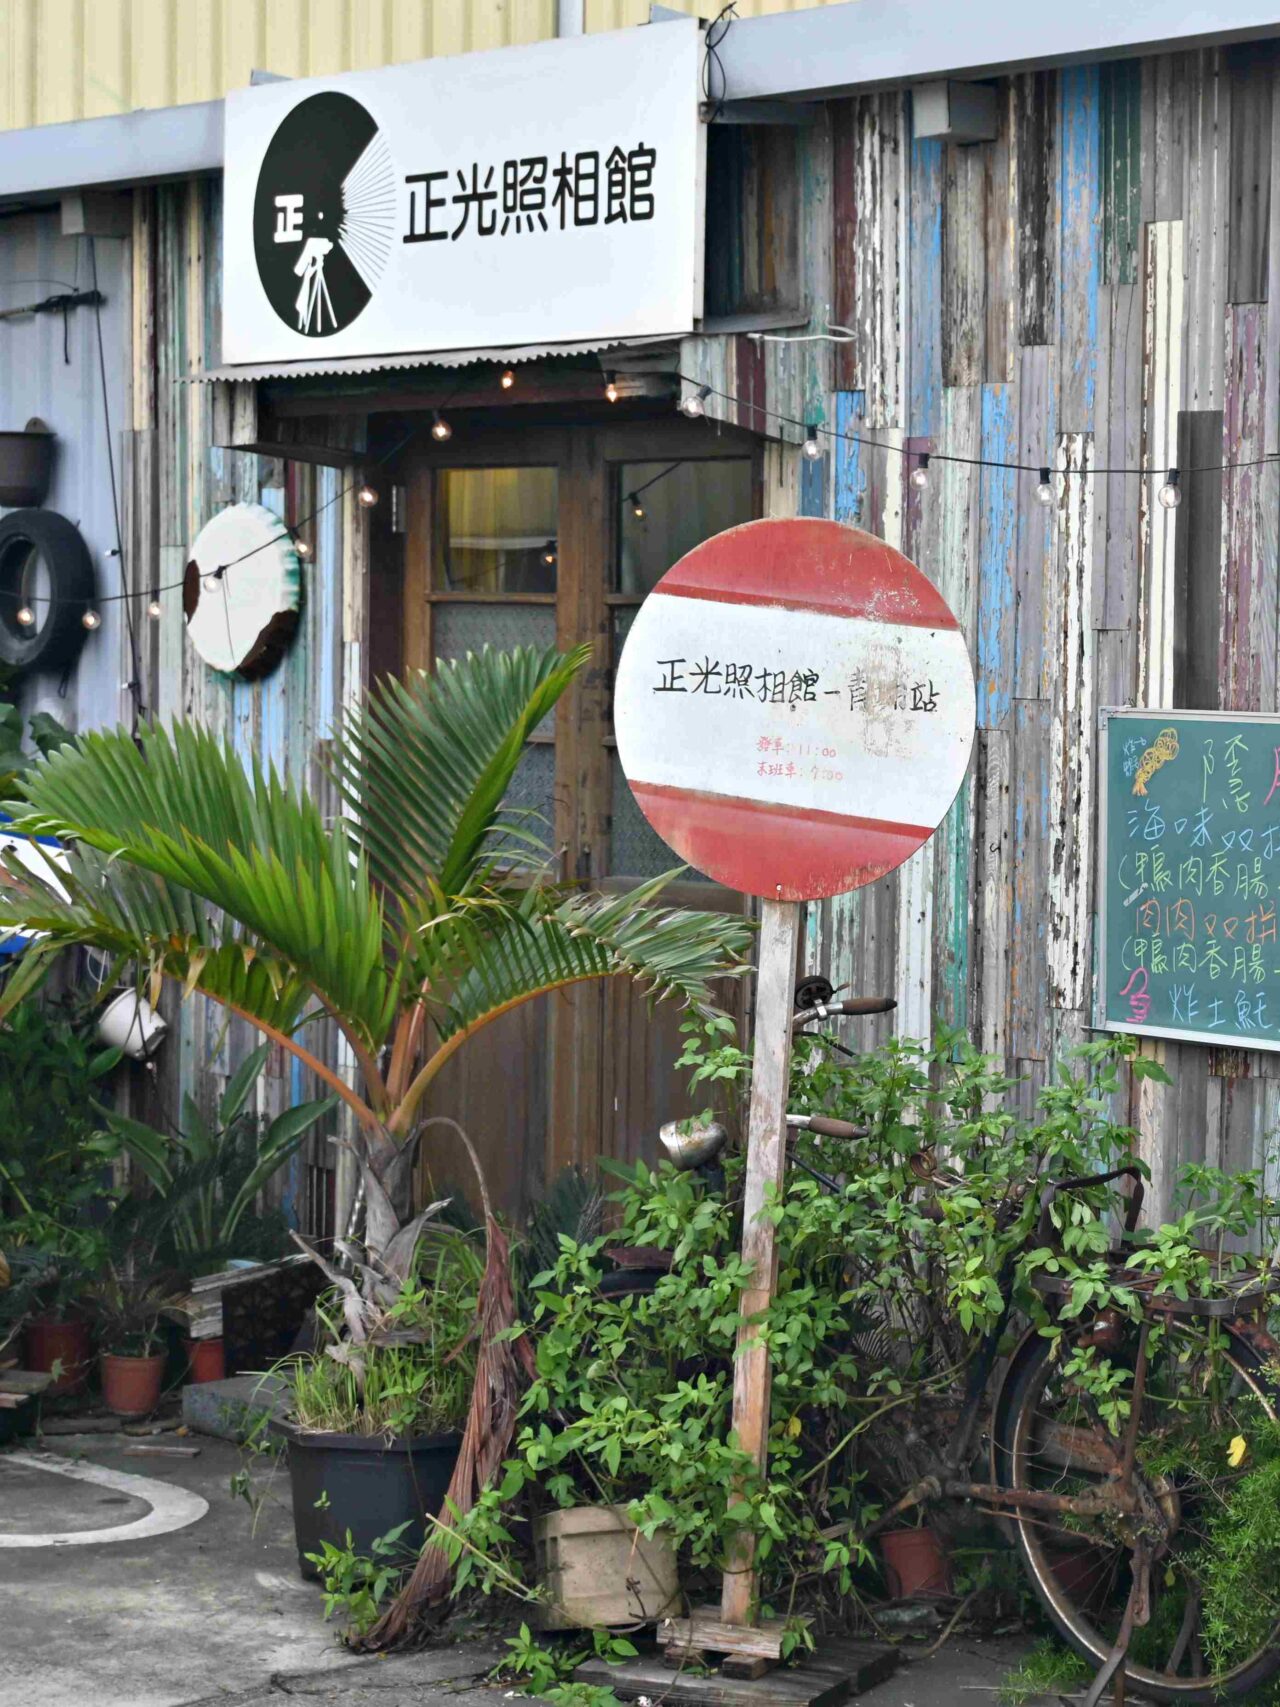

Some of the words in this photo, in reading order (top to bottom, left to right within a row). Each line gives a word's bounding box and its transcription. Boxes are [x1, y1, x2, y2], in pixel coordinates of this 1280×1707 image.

[273, 193, 304, 244] 正
[402, 141, 657, 245] 正光照相館
